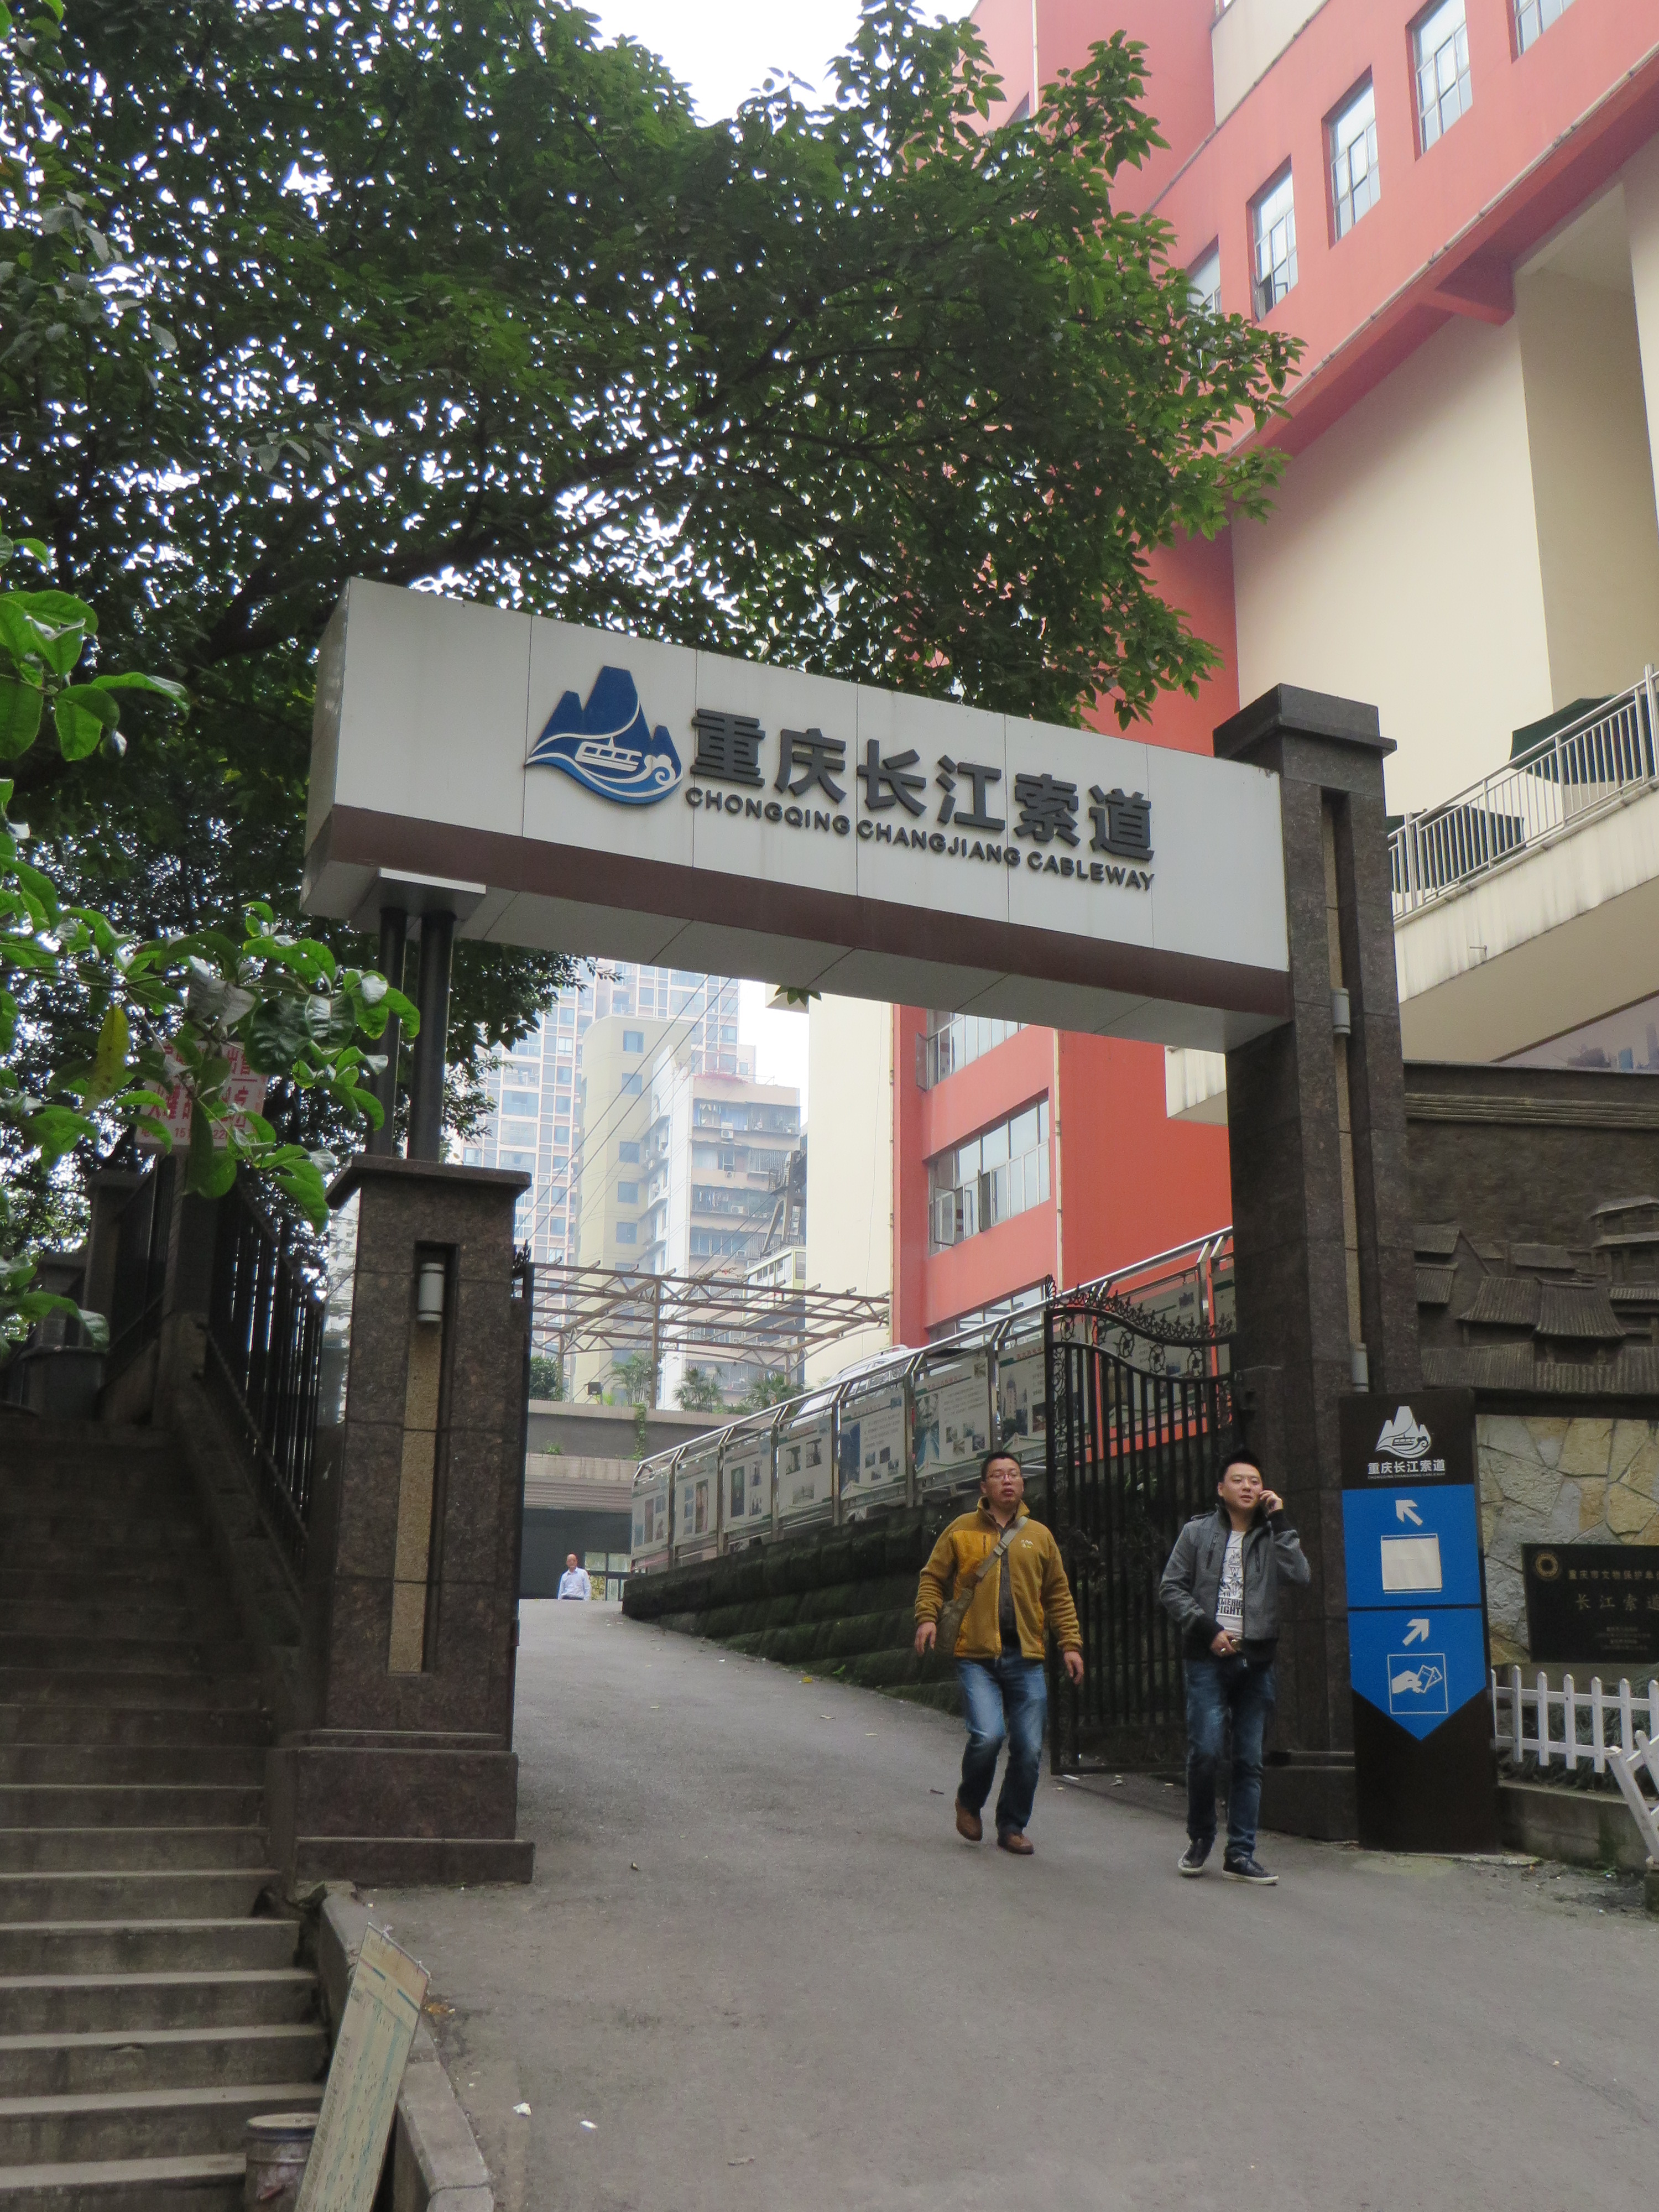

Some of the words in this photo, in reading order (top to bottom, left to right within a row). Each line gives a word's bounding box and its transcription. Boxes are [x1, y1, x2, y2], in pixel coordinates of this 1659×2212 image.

[690, 708, 1155, 861] 重庆长江索道
[685, 787, 850, 835] CHONGQING
[857, 819, 1021, 867] CHANGJIANG
[1027, 851, 1155, 891] CABLEWAY
[1368, 1459, 1446, 1474] 重庆长江索道
